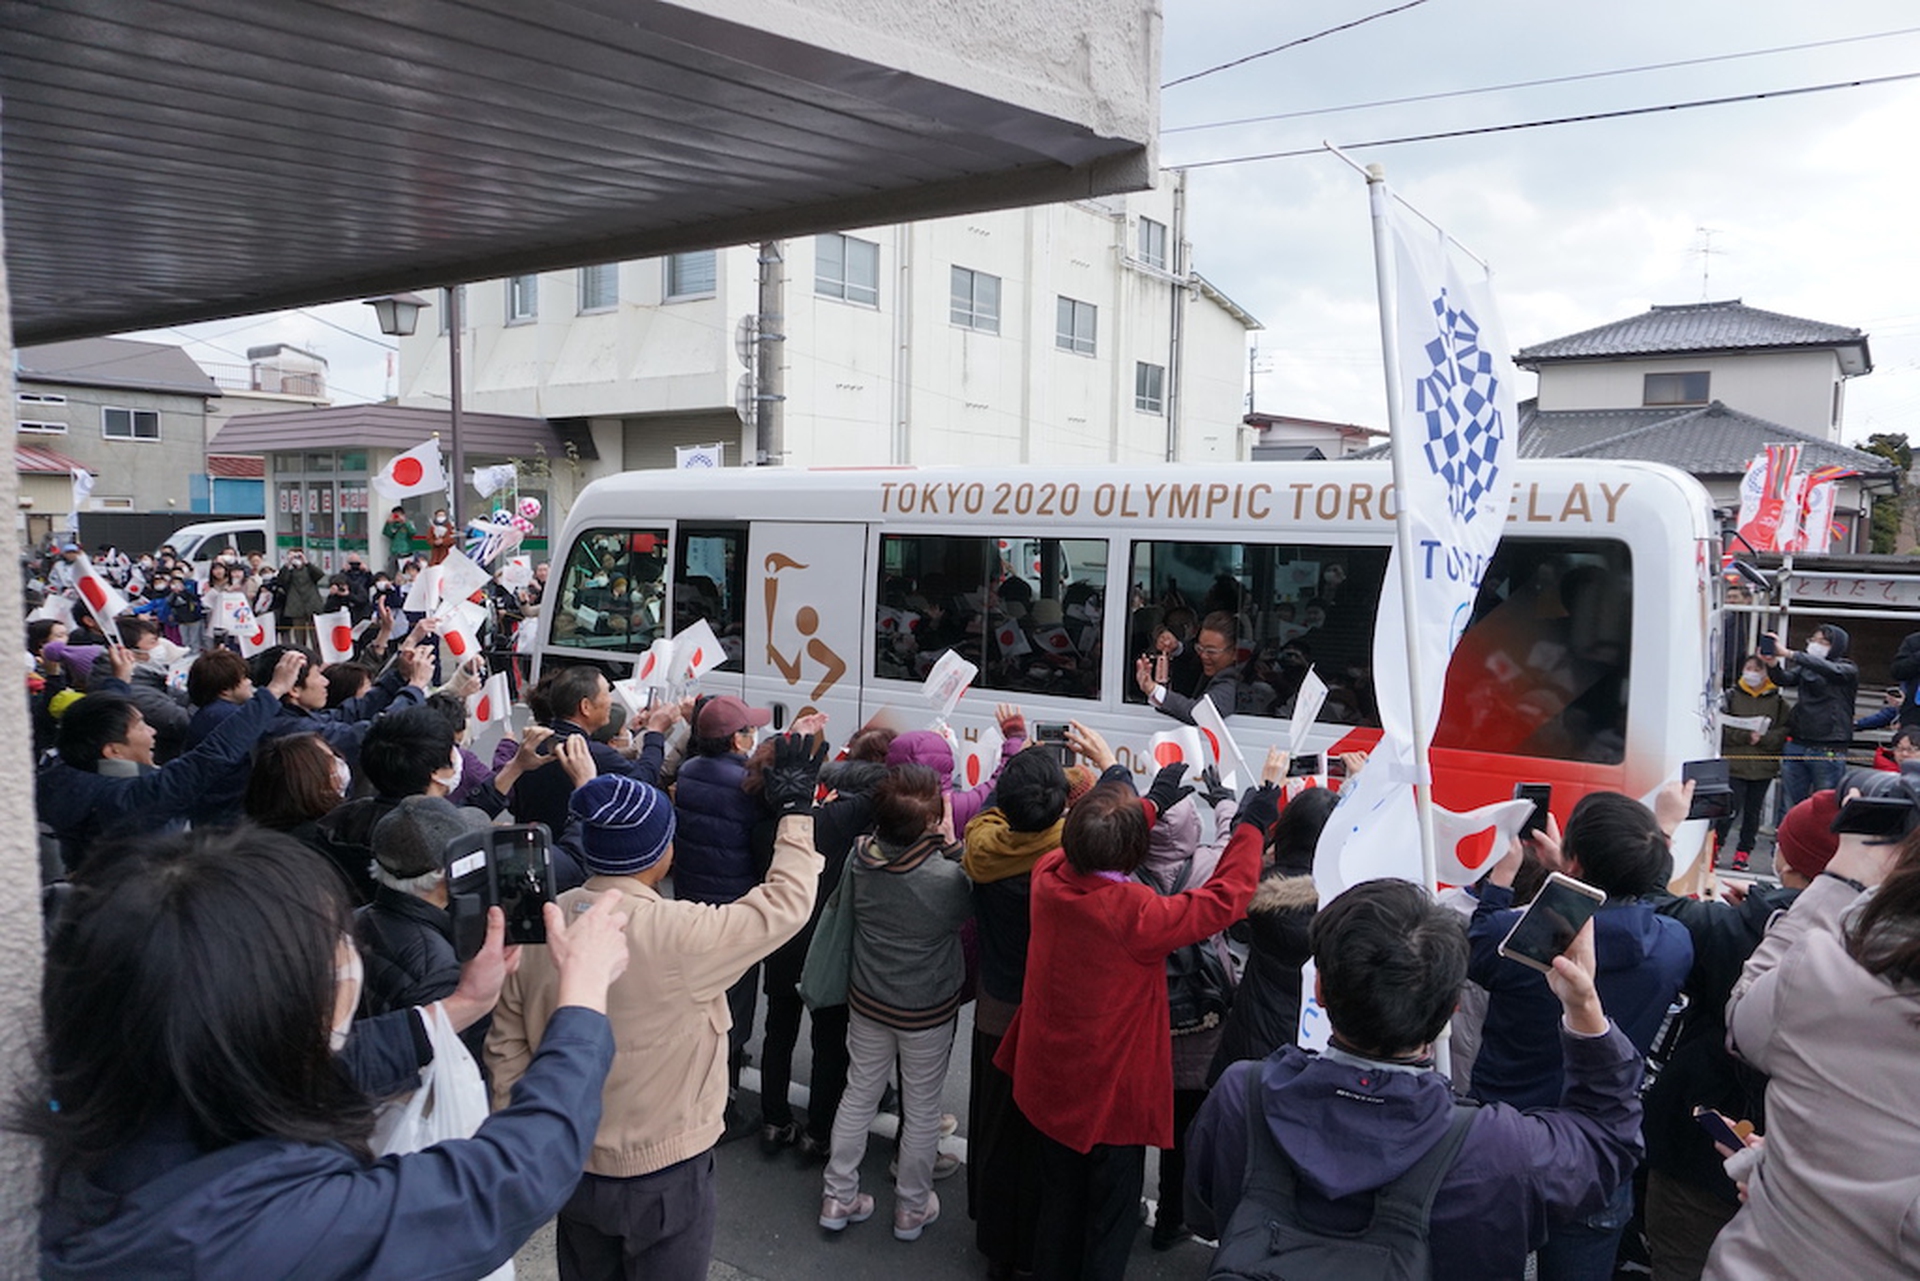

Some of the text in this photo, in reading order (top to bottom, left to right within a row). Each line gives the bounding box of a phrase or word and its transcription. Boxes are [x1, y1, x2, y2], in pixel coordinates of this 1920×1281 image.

[880, 483, 983, 515] TOKYO
[992, 483, 1080, 516] 2020
[1093, 483, 1272, 519] OLYMPIC
[1289, 484, 1396, 520] TORC
